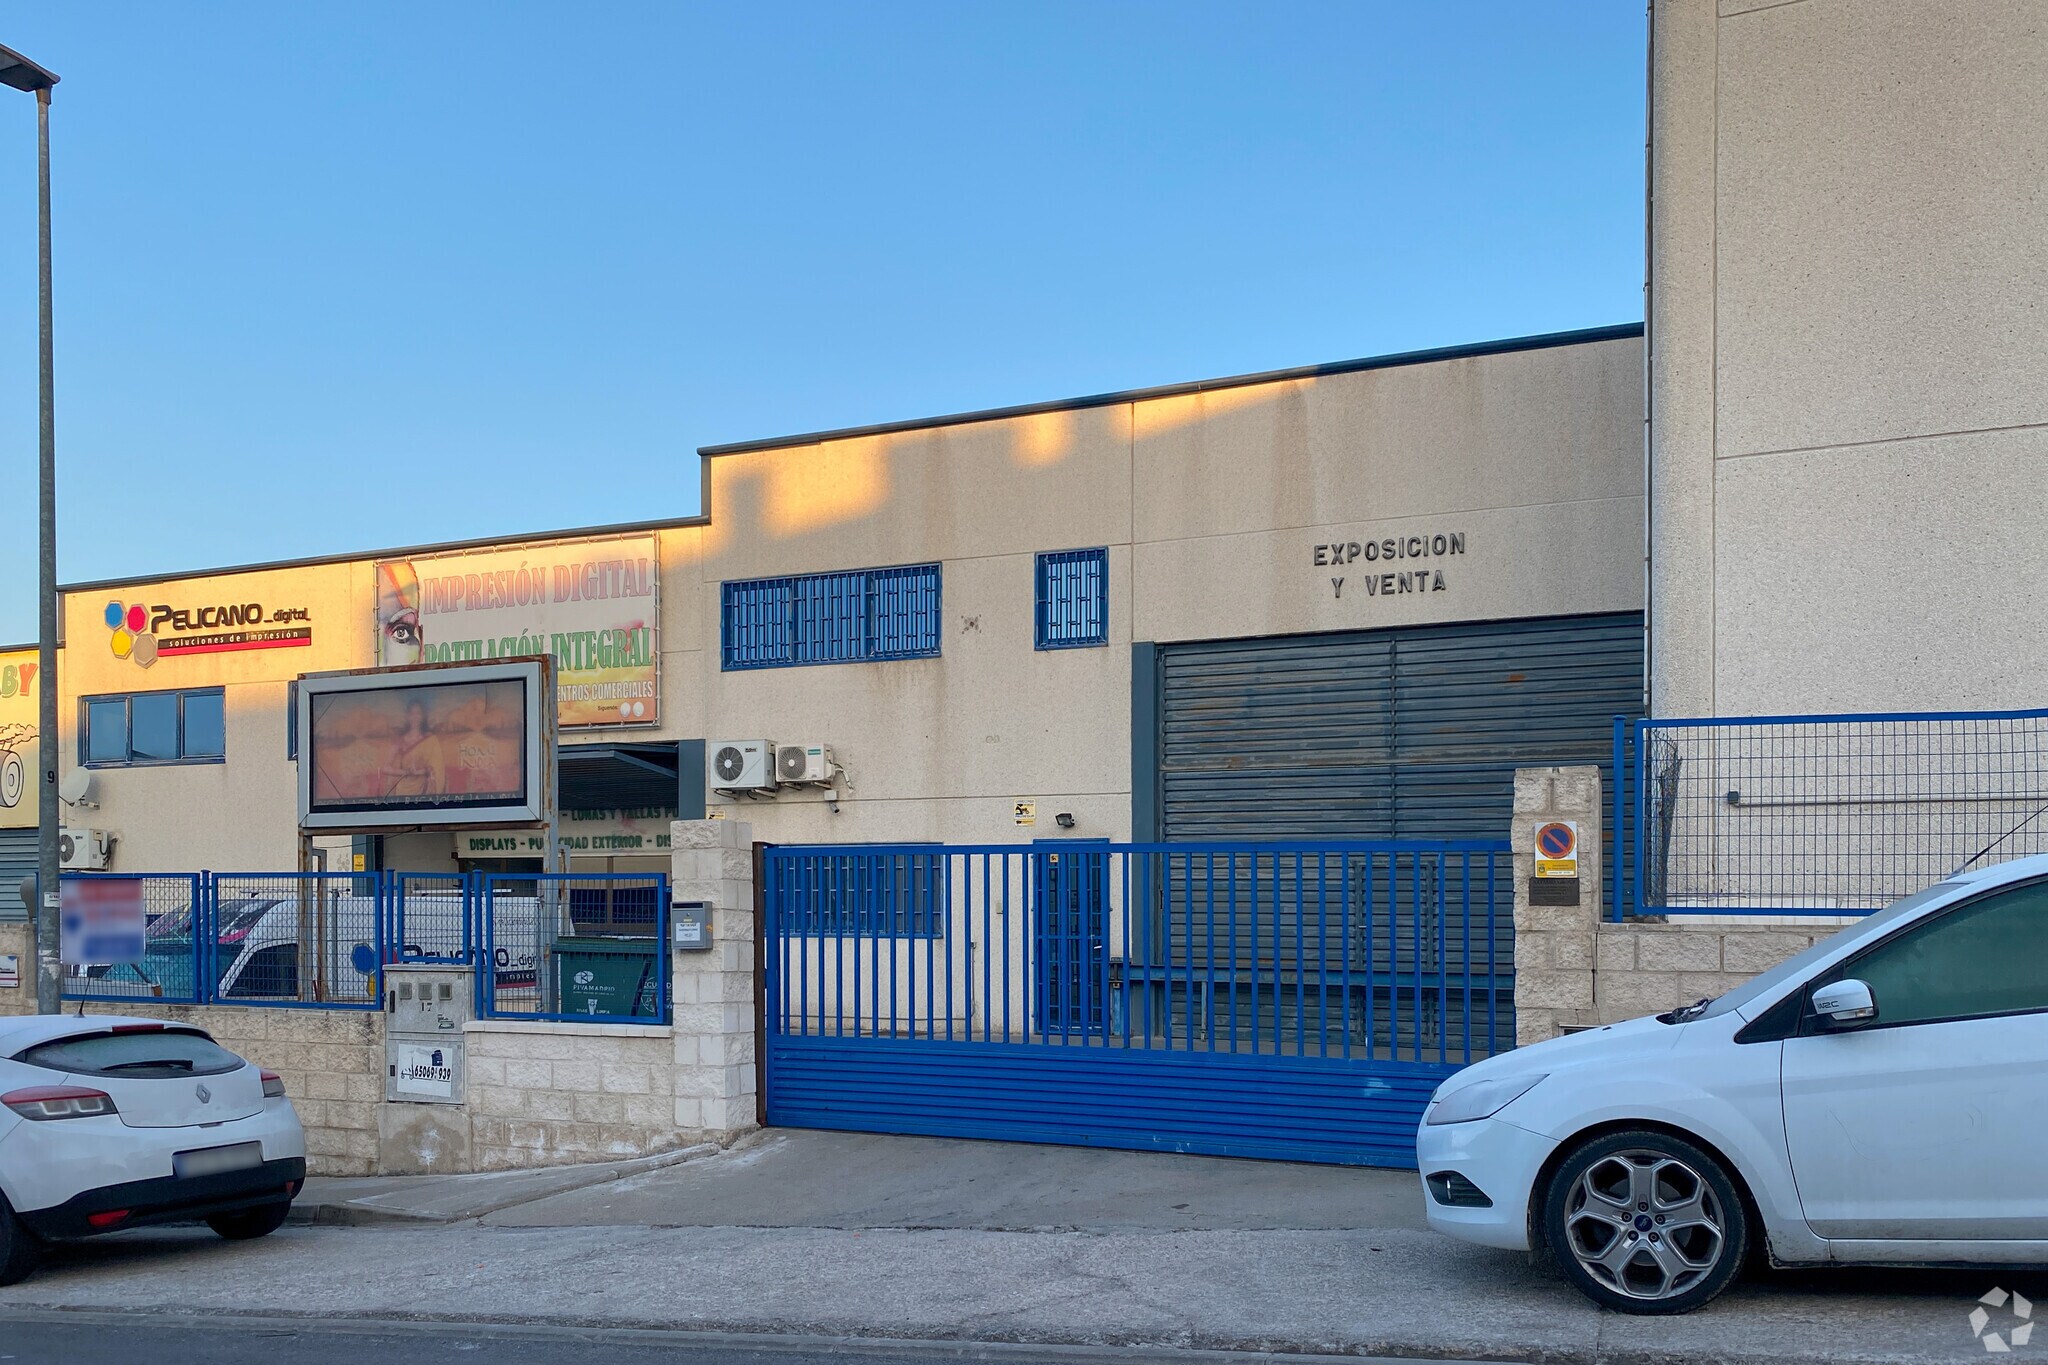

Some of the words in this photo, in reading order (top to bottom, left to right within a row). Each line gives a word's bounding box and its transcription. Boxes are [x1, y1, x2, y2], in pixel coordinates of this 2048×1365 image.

[1314, 532, 1465, 566] EXPOSICION
[424, 561, 546, 614] IMPRESIÓN
[553, 558, 651, 603] DIGITAL
[1331, 577, 1345, 599] Y
[1365, 570, 1446, 596] VENTA
[169, 636, 224, 647] soluciones
[229, 633, 241, 643] de
[246, 630, 299, 641] impresión
[551, 627, 653, 671] INTEGRAL
[0, 663, 38, 698] BY
[558, 684, 589, 702] ENTROS
[592, 681, 653, 700] COMERCIALES
[47, 771, 55, 783] 9
[469, 838, 517, 851] DISPLAYS
[592, 834, 642, 849] EXTERIOR
